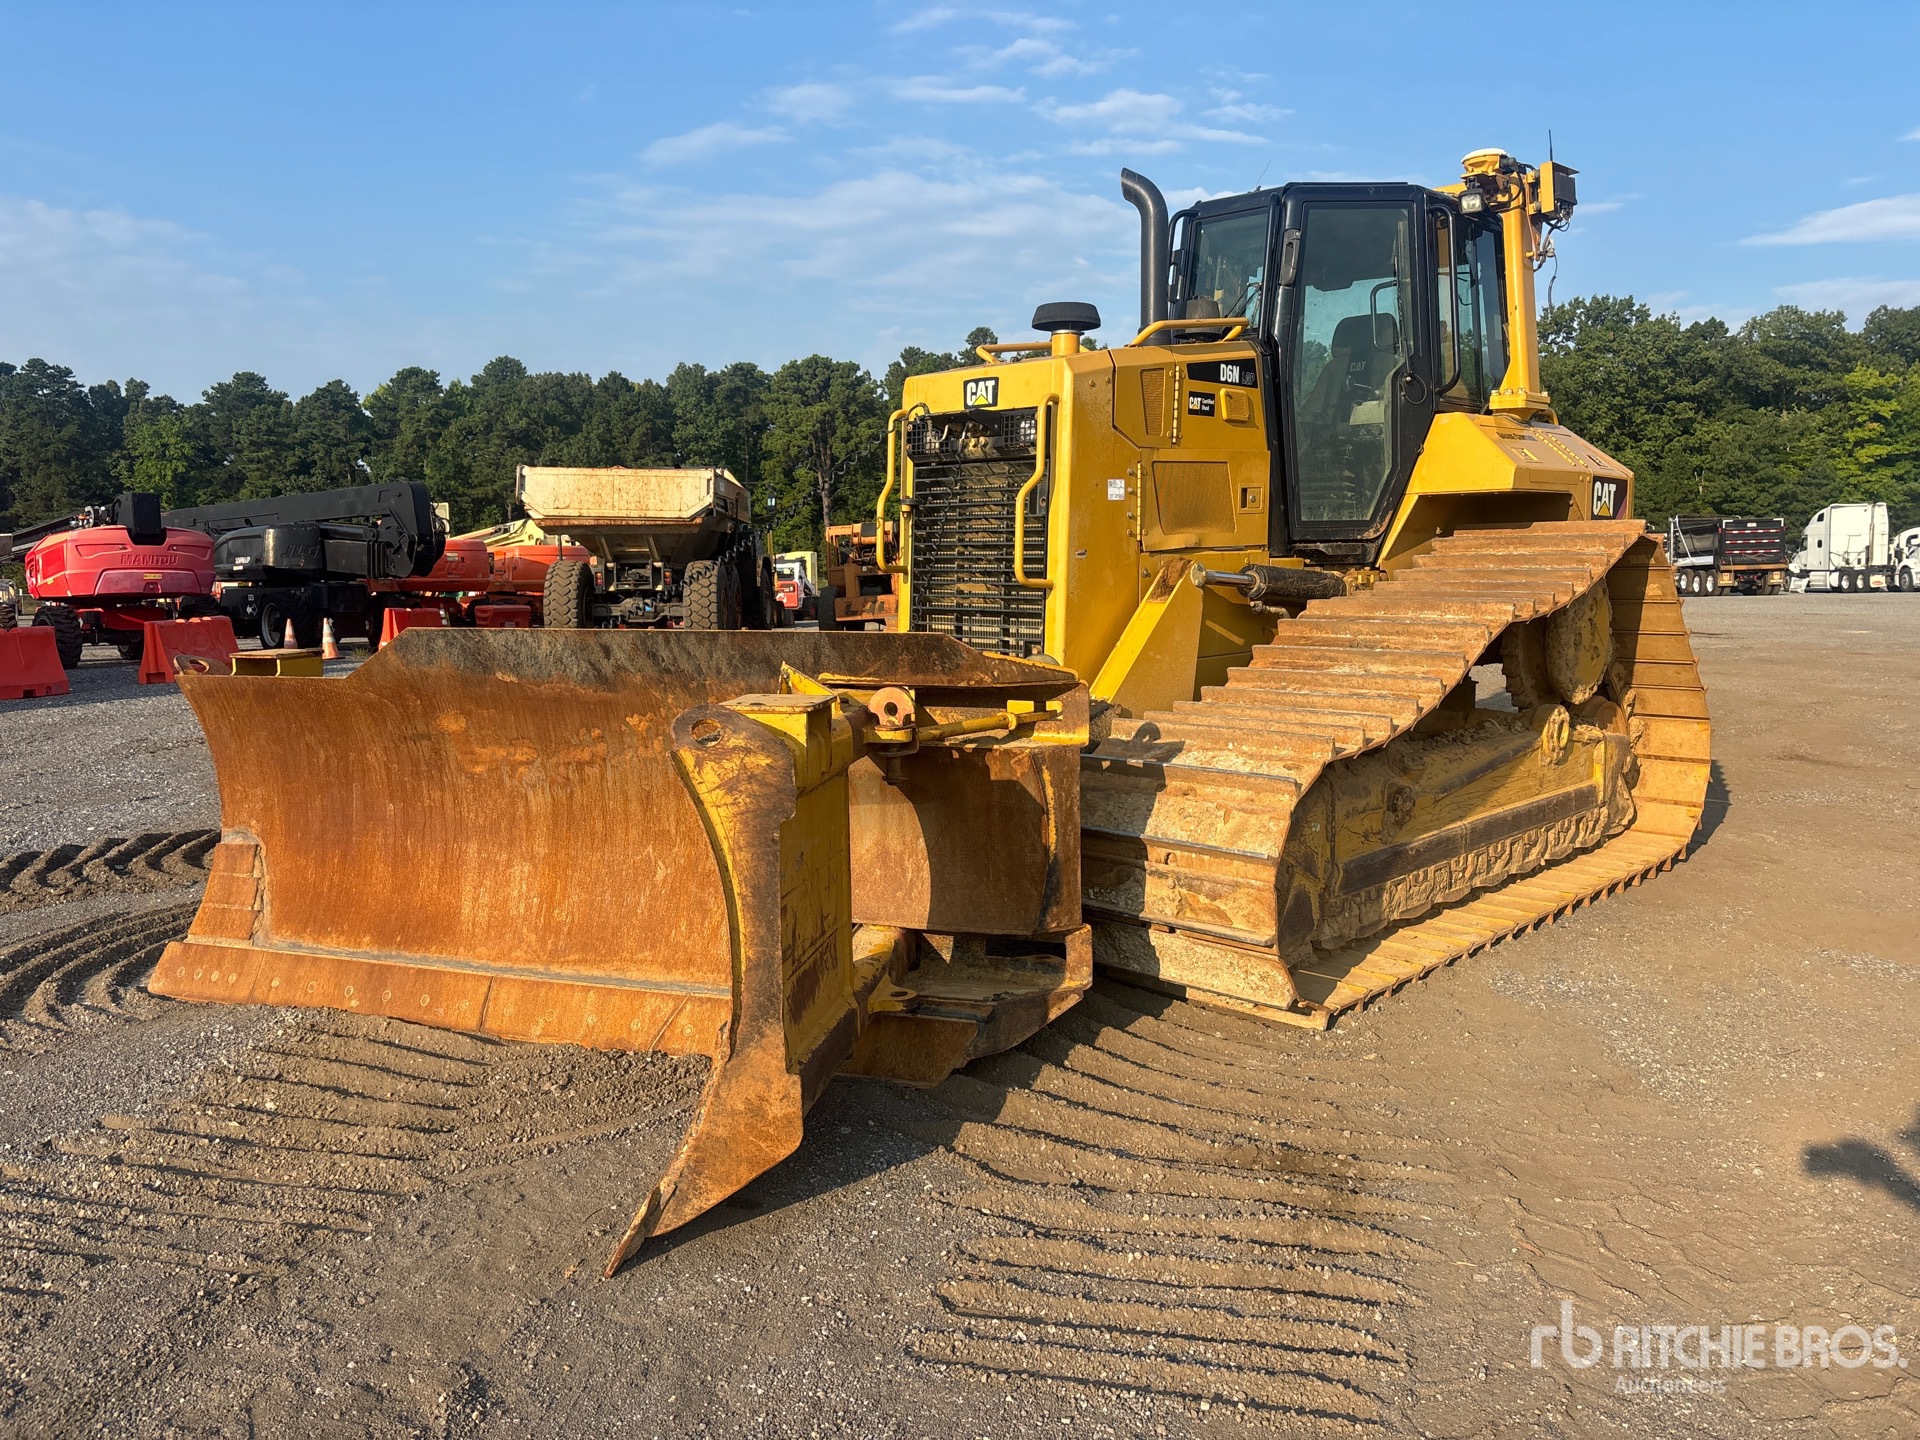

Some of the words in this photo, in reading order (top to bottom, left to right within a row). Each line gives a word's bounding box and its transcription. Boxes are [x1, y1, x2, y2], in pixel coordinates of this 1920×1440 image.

[1220, 363, 1240, 383] D6N
[1350, 361, 1367, 372] CAT
[966, 379, 996, 407] CAT
[1189, 396, 1202, 410] CAT
[1593, 481, 1616, 516] CAT
[120, 554, 179, 566] MANITOU
